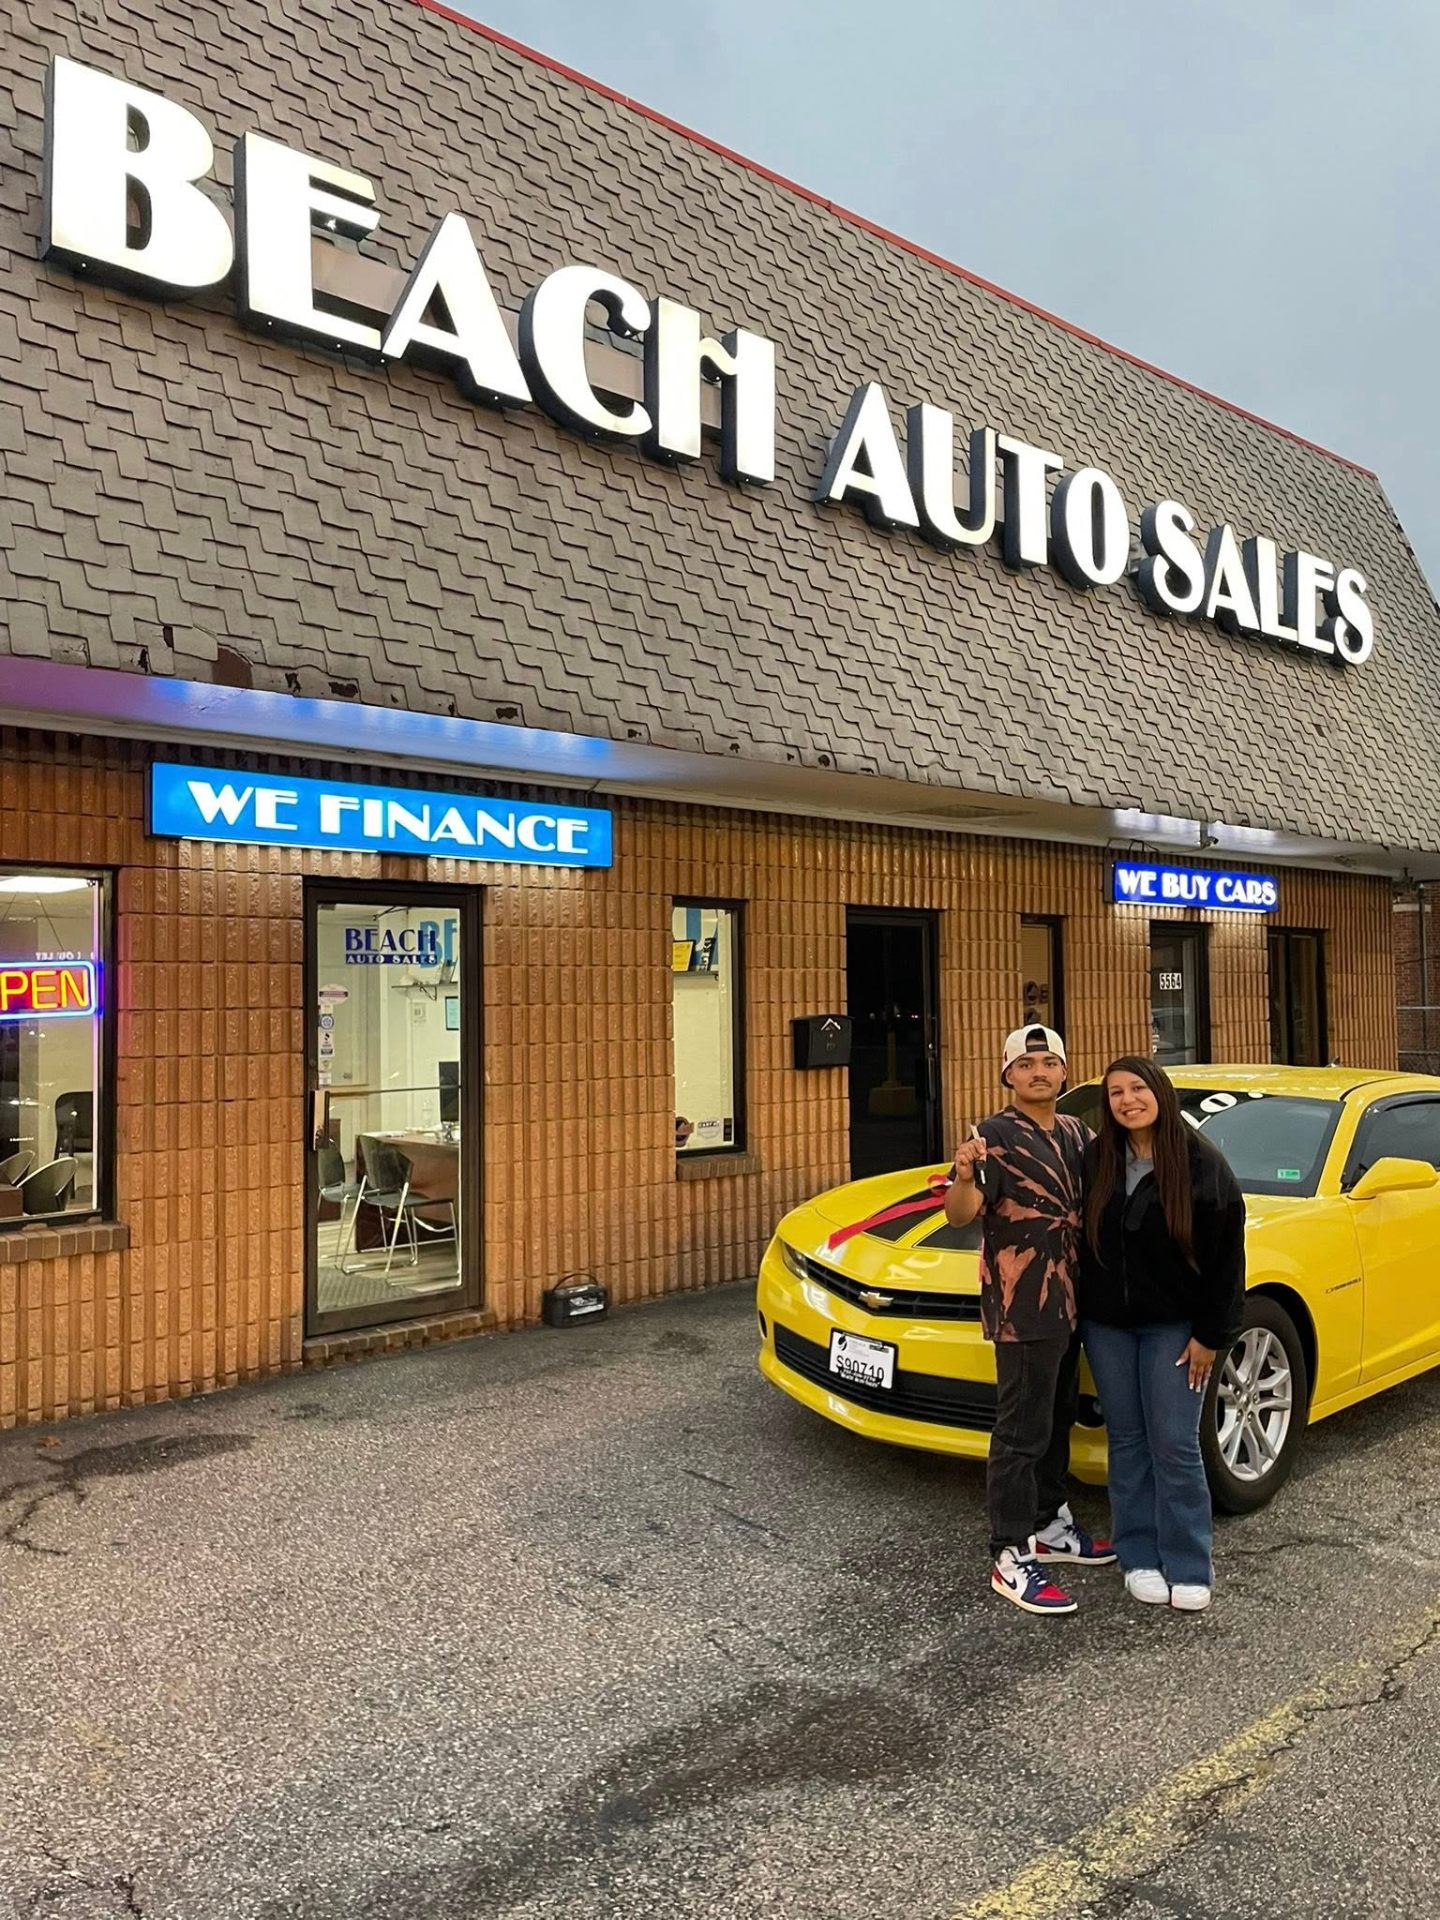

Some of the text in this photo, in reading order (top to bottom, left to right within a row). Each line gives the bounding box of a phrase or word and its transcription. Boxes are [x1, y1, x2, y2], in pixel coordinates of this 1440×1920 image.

[46, 54, 1374, 666] BEACH AUTO SALES
[187, 781, 590, 854] WE FINANCE
[1118, 868, 1277, 906] WE BUY CARS
[345, 927, 437, 953] BEACH
[346, 954, 437, 964] AUTO SALES
[1159, 973, 1182, 990] 5564
[835, 1355, 885, 1382] S90710
